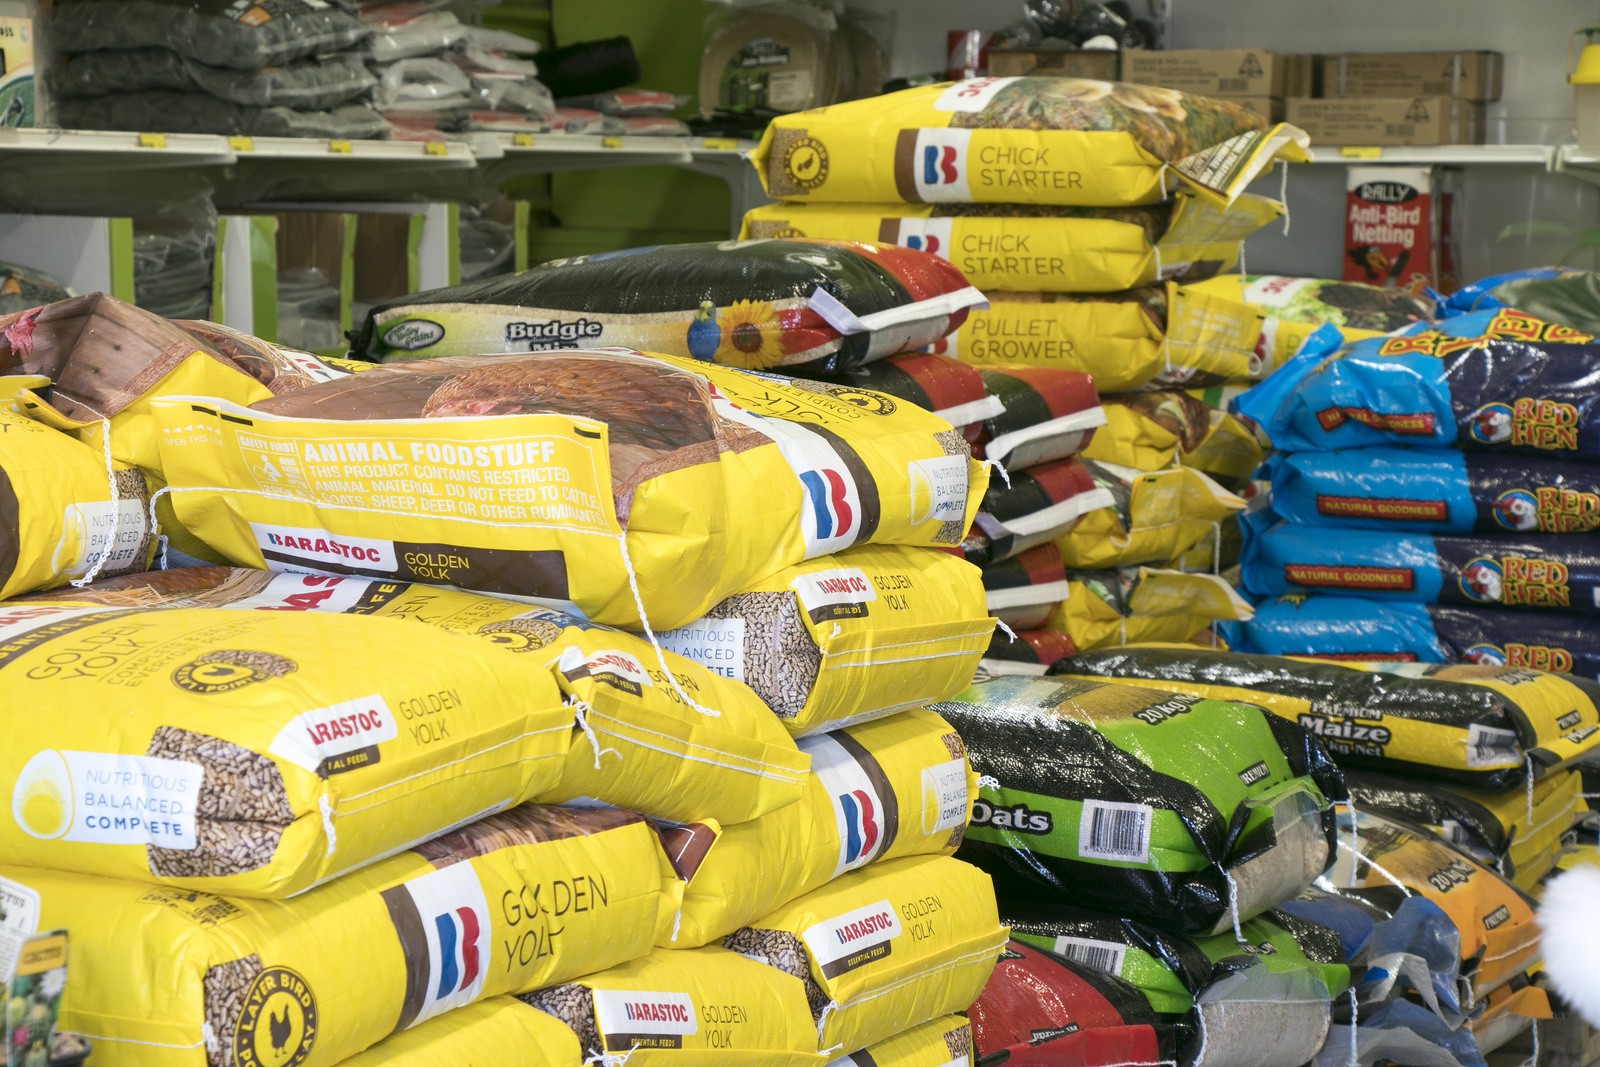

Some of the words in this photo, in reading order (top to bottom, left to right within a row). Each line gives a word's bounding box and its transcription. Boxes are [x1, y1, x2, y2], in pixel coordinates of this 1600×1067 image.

[980, 146, 1049, 166] CHICK
[980, 169, 1083, 189] STARTER
[1361, 184, 1411, 202] RALLY
[1350, 204, 1421, 226] Anti-Bird
[962, 234, 1030, 253] CHICK
[1352, 224, 1415, 249] Netting
[963, 257, 1065, 276] STARTER
[509, 320, 602, 340] Budgie
[971, 319, 1058, 337] PULLET
[970, 340, 1075, 360] GROWER
[1513, 397, 1579, 427] RED
[188, 434, 209, 445] THIS
[1512, 421, 1579, 450] HEN
[304, 442, 404, 462] ANIMAL
[409, 441, 555, 467] FOODSTUFF
[308, 465, 342, 479] THIS
[343, 463, 410, 479] PRODUCT
[413, 464, 481, 483] CONTAINS
[483, 466, 571, 486] RESTRICTED
[315, 480, 369, 494] ANIMAL
[370, 479, 442, 497] MATERIAL.
[446, 484, 466, 498] DO
[467, 486, 495, 502] NOT
[498, 486, 536, 504] FEED
[538, 485, 559, 503] TO
[1537, 487, 1600, 515] RED
[371, 494, 418, 513] SHEEP,
[421, 497, 456, 514] DEER
[458, 500, 477, 517] OR
[480, 504, 528, 520] OTHER
[1324, 500, 1374, 514] NATURAL
[1377, 503, 1439, 517] GOODNESS
[92, 511, 142, 528] NUTRTIOUS
[90, 530, 139, 547] BALNCED
[267, 532, 382, 563] BARASTOC
[85, 548, 135, 564] COPLETE
[404, 552, 470, 570] GOLDEN
[407, 565, 451, 581] YOLK
[873, 574, 914, 591] GOLDEN
[1290, 569, 1341, 583] NATURAL
[1343, 570, 1405, 584] GOODNESS
[1502, 556, 1570, 587] RED
[883, 594, 911, 611] YOLK
[1502, 583, 1571, 607] HEN
[26, 622, 158, 681] GOLDEN
[60, 638, 158, 681] YOLK
[1503, 642, 1573, 674] RED
[648, 669, 700, 692] GODEN
[398, 687, 462, 721] GOLDEN
[408, 718, 451, 747] YOLK
[1300, 715, 1390, 743] Maize
[85, 769, 188, 793] NUTRITIOUS
[1240, 762, 1271, 785] REMIUM
[85, 792, 183, 815] BALANCED
[85, 815, 184, 836] COMPETE
[971, 800, 1050, 832] Oats
[1430, 873, 1451, 890] 20
[501, 873, 608, 927] GODEN
[901, 894, 944, 921] GOLDEN
[835, 911, 894, 945] BARASTOC
[909, 919, 936, 943] YOLK
[241, 975, 277, 1031] LAYER
[279, 973, 312, 1008] BIRD
[624, 1002, 690, 1023] BARASTOC
[701, 1005, 748, 1024] GOLDEN
[658, 1037, 676, 1048] FEEDS
[704, 1029, 733, 1049] YOLK
